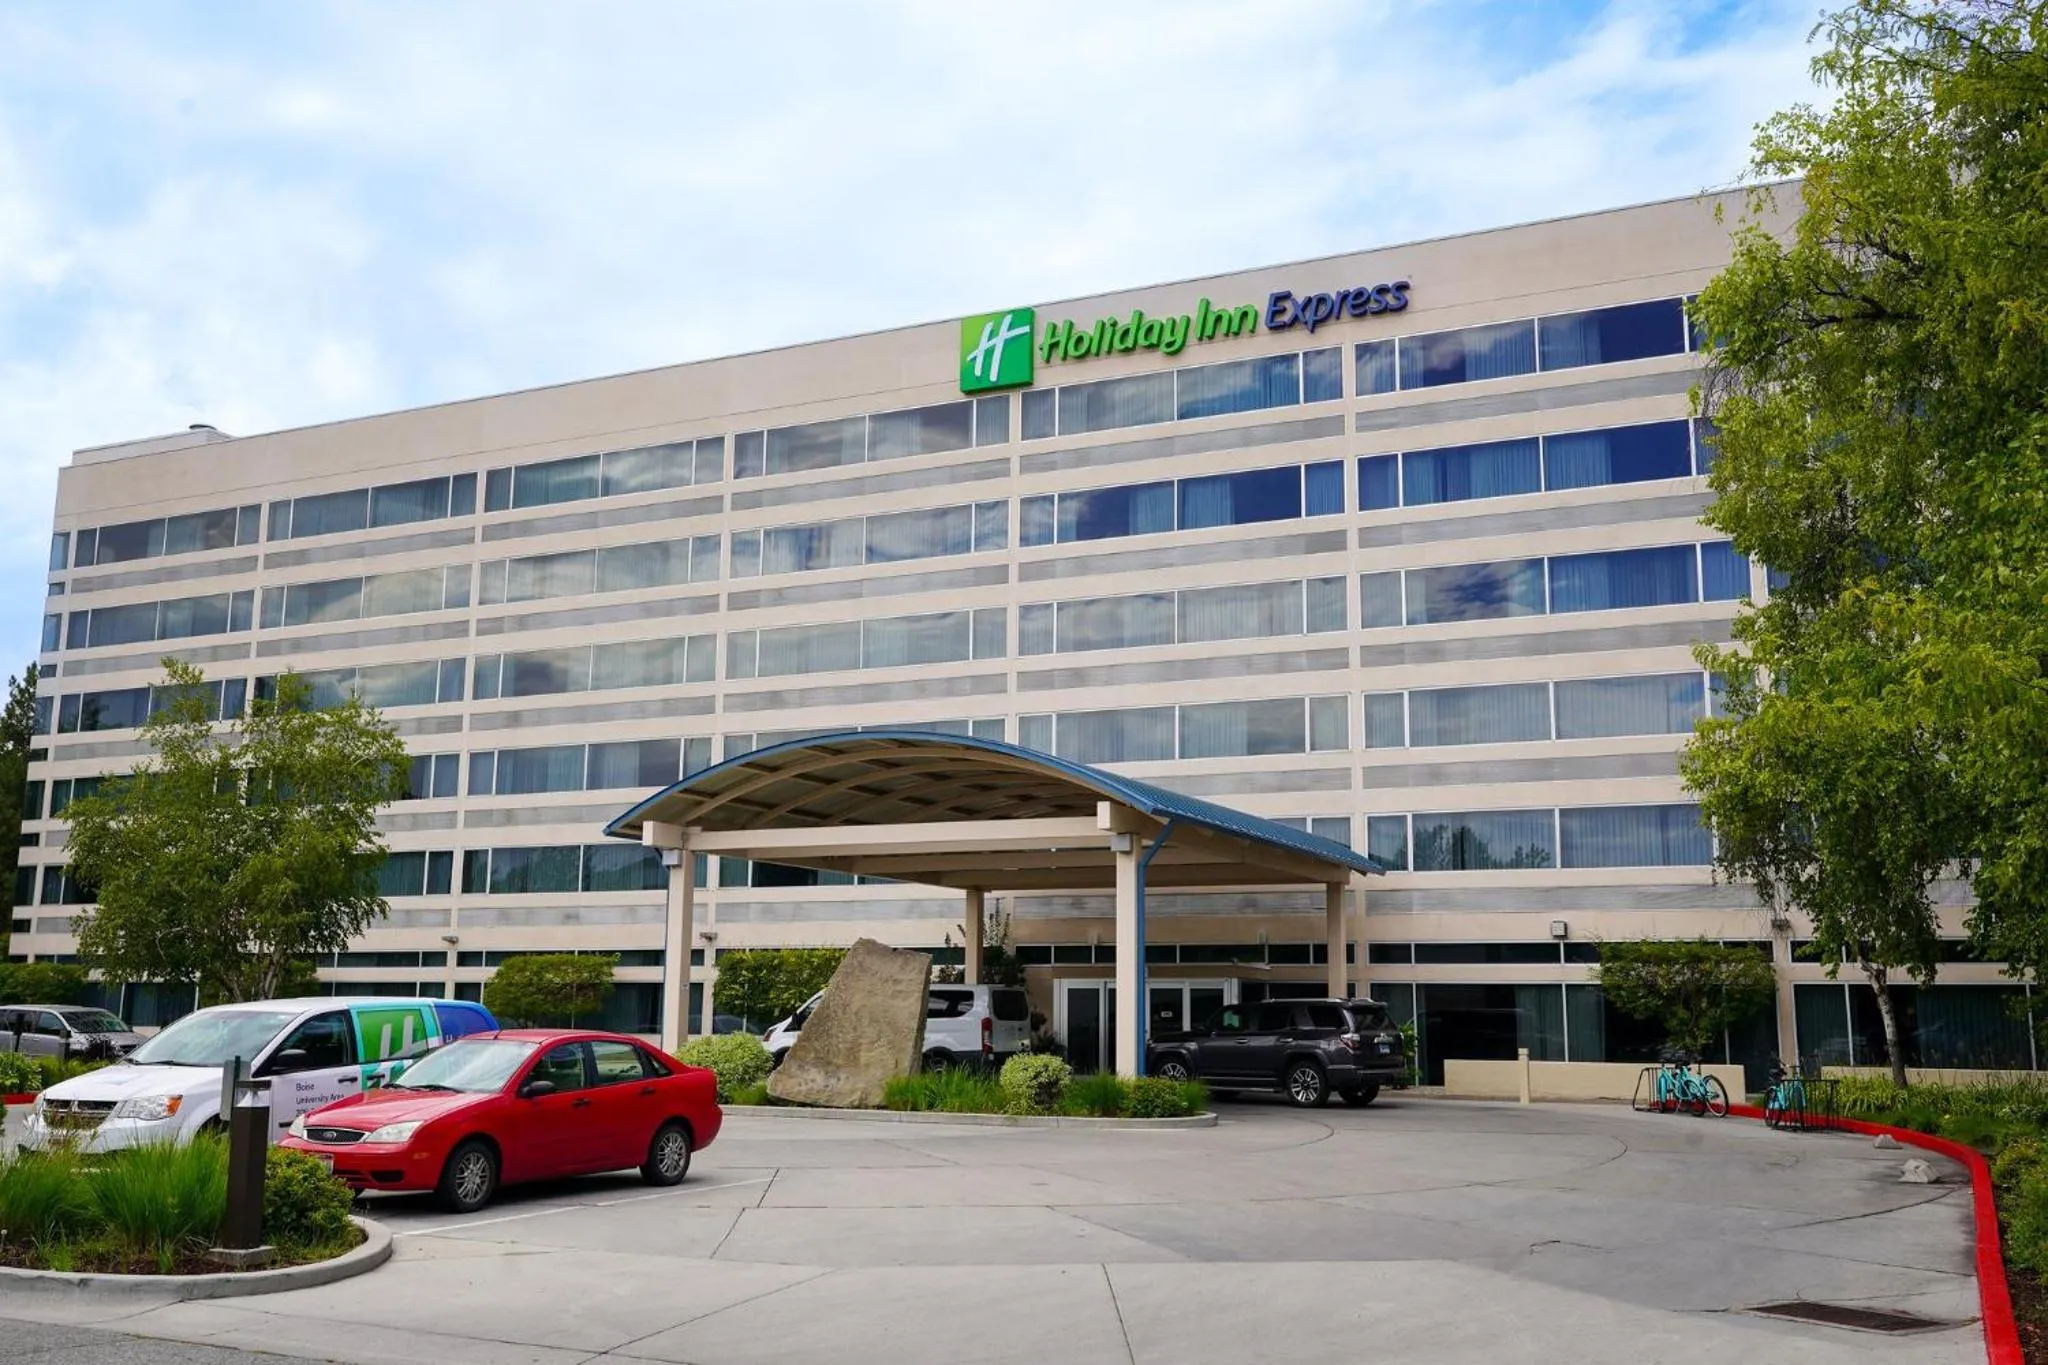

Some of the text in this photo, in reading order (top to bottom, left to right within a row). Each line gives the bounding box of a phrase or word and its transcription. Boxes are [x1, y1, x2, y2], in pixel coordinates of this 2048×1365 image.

[1039, 280, 1411, 363] Holiday Inn Express
